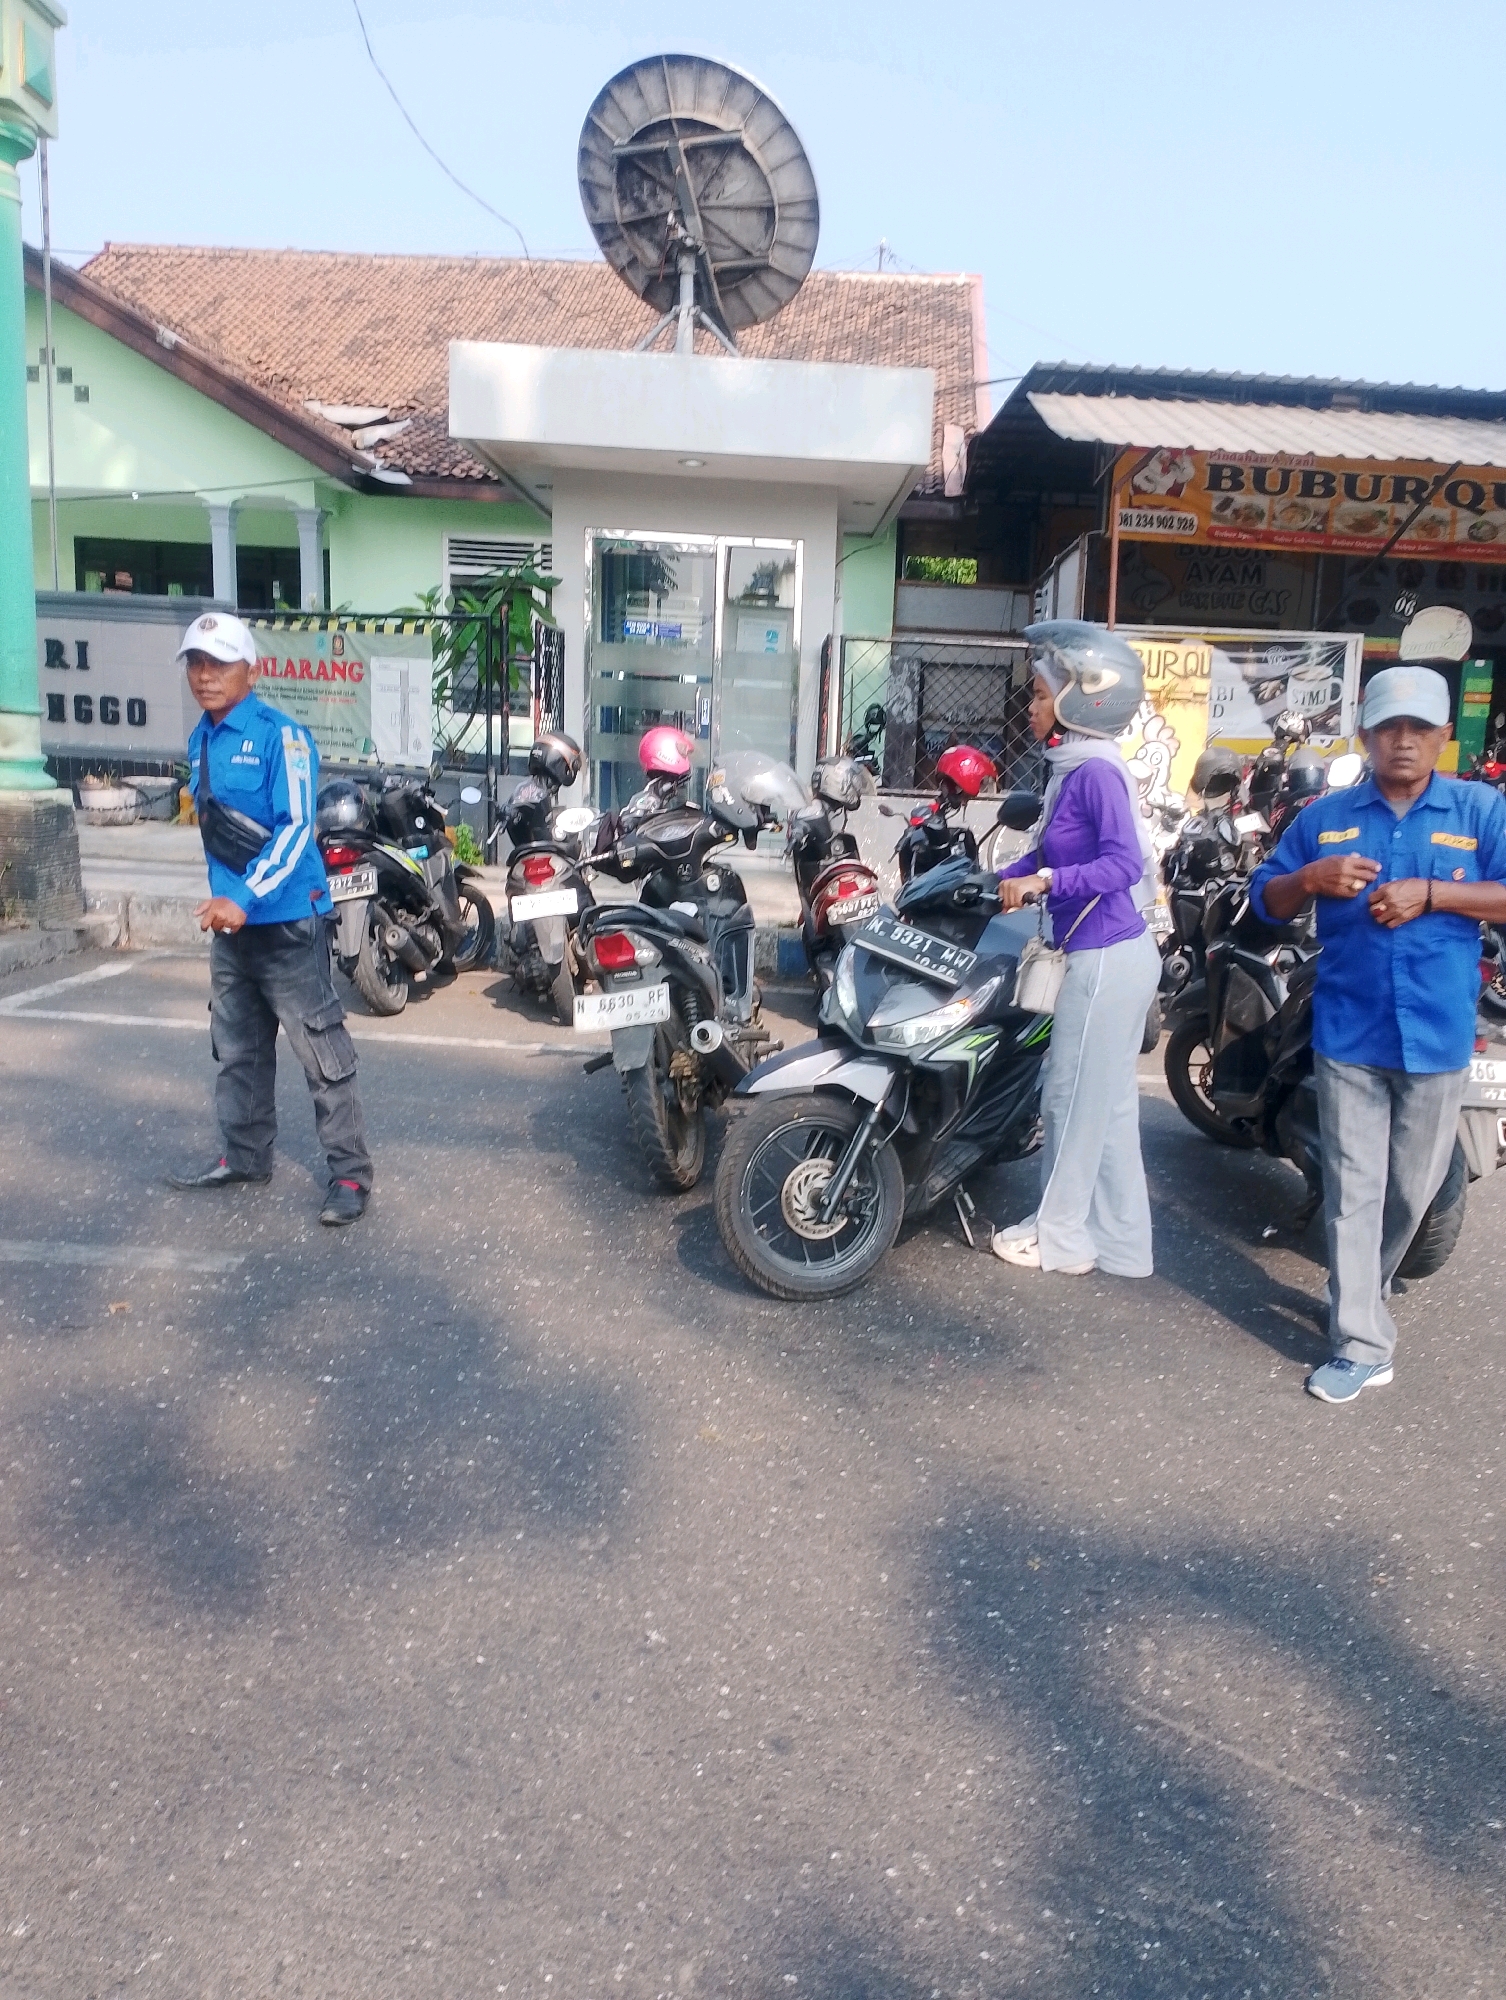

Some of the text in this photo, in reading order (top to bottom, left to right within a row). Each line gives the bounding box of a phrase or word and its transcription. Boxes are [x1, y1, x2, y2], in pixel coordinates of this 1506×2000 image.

[1135, 513, 1154, 529] 234
[1156, 515, 1174, 531] 902
[1177, 517, 1196, 532] 928
[1186, 561, 1263, 585] AYAM
[44, 638, 90, 671] RI
[257, 657, 364, 683] ILARANG
[1293, 688, 1328, 707] STMJ
[46, 693, 146, 727] NGGO
[648, 988, 665, 1005] RF
